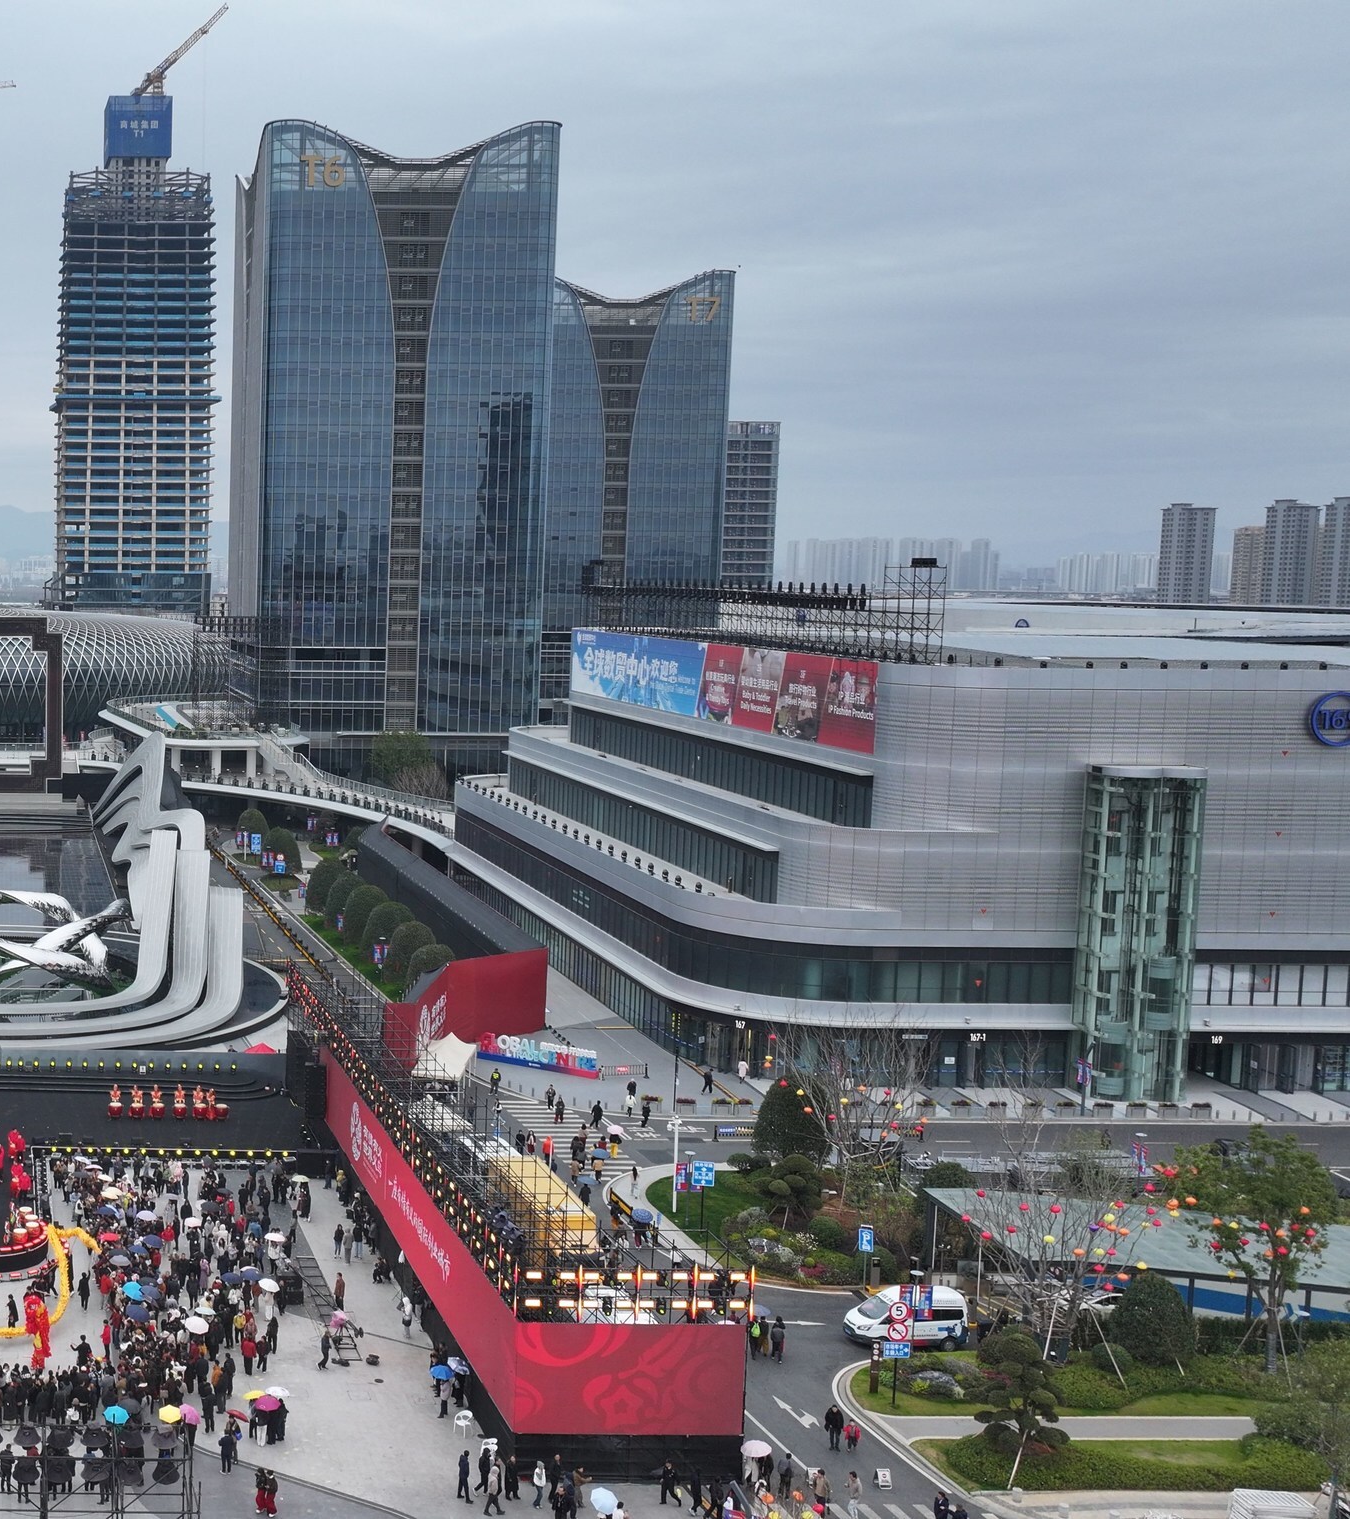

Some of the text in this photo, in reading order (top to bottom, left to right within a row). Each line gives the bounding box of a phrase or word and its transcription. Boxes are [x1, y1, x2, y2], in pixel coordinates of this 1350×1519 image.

[120, 120, 158, 129] 商城集团
[300, 155, 344, 187] T6
[685, 296, 720, 322] T7
[584, 646, 678, 686] 全球数贸中心 欢迎您
[742, 690, 752, 700] Baby
[755, 692, 771, 701] Toddler
[741, 701, 750, 711] Daily
[799, 698, 817, 710] Products
[834, 706, 851, 717] Fashion
[852, 709, 874, 721] Products
[1322, 710, 1350, 730] 16
[735, 1020, 746, 1029] 167
[970, 1033, 986, 1041] 167-1
[1211, 1036, 1223, 1044] 169
[896, 1306, 903, 1316] 5
